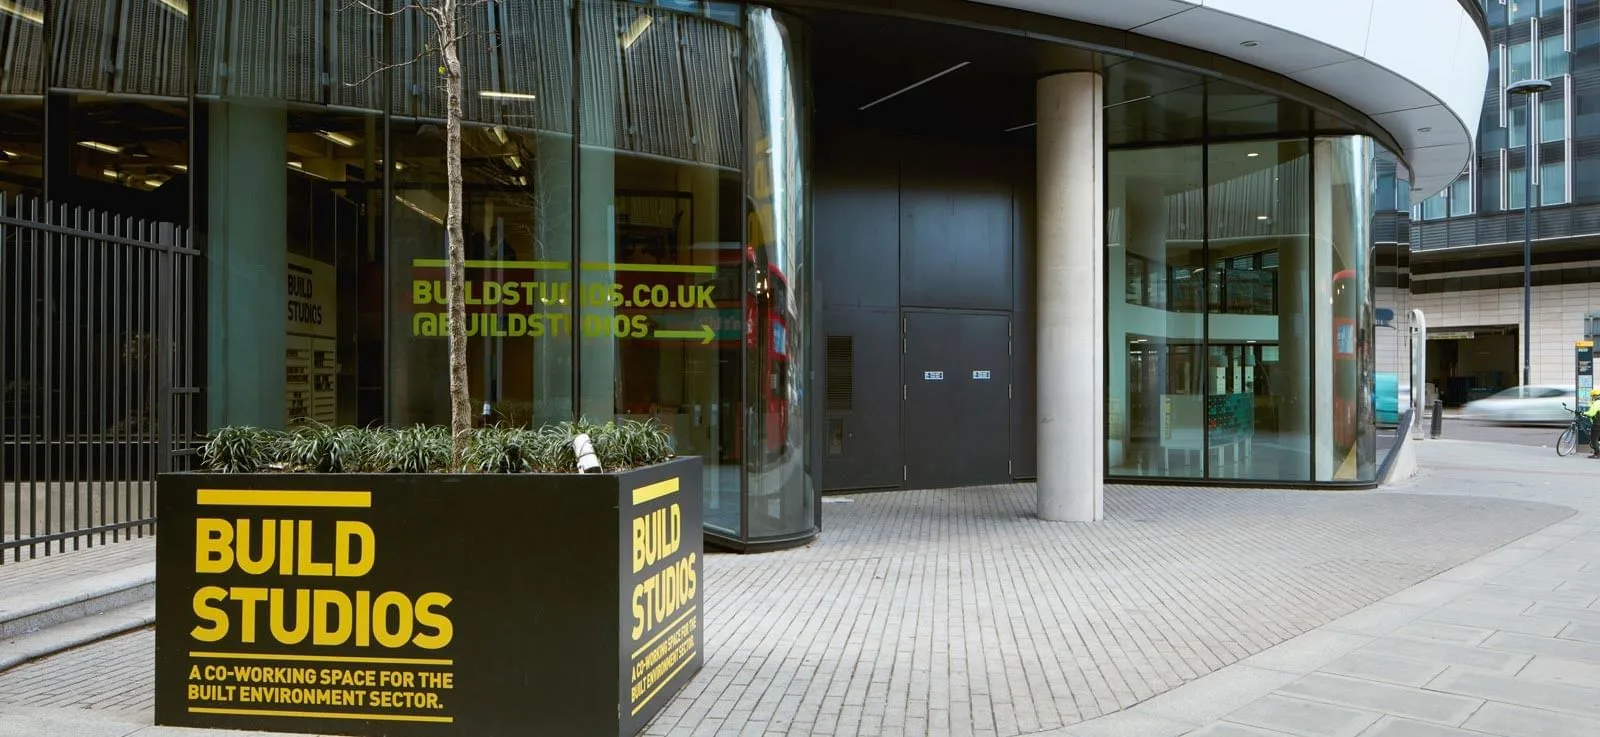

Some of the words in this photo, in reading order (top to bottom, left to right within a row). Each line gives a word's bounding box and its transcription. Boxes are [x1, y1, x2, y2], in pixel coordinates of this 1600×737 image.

[287, 274, 313, 299] BUILD
[412, 279, 716, 308] BULDSTUDIOS.CO.UK
[287, 301, 322, 325] STUDIOS
[195, 517, 376, 577] BUILD
[632, 503, 681, 574] BUILD
[632, 552, 697, 641] STUDIOS
[190, 585, 454, 650] STUDIOS
[188, 664, 202, 681] A
[204, 665, 317, 685] CO-WORKING
[319, 668, 376, 688] SPACE
[379, 670, 415, 688] FOR
[417, 672, 454, 689] THE
[187, 684, 235, 701] BUILT
[239, 686, 367, 707] ENVIRONMENT
[368, 690, 444, 709] SECTOR.
